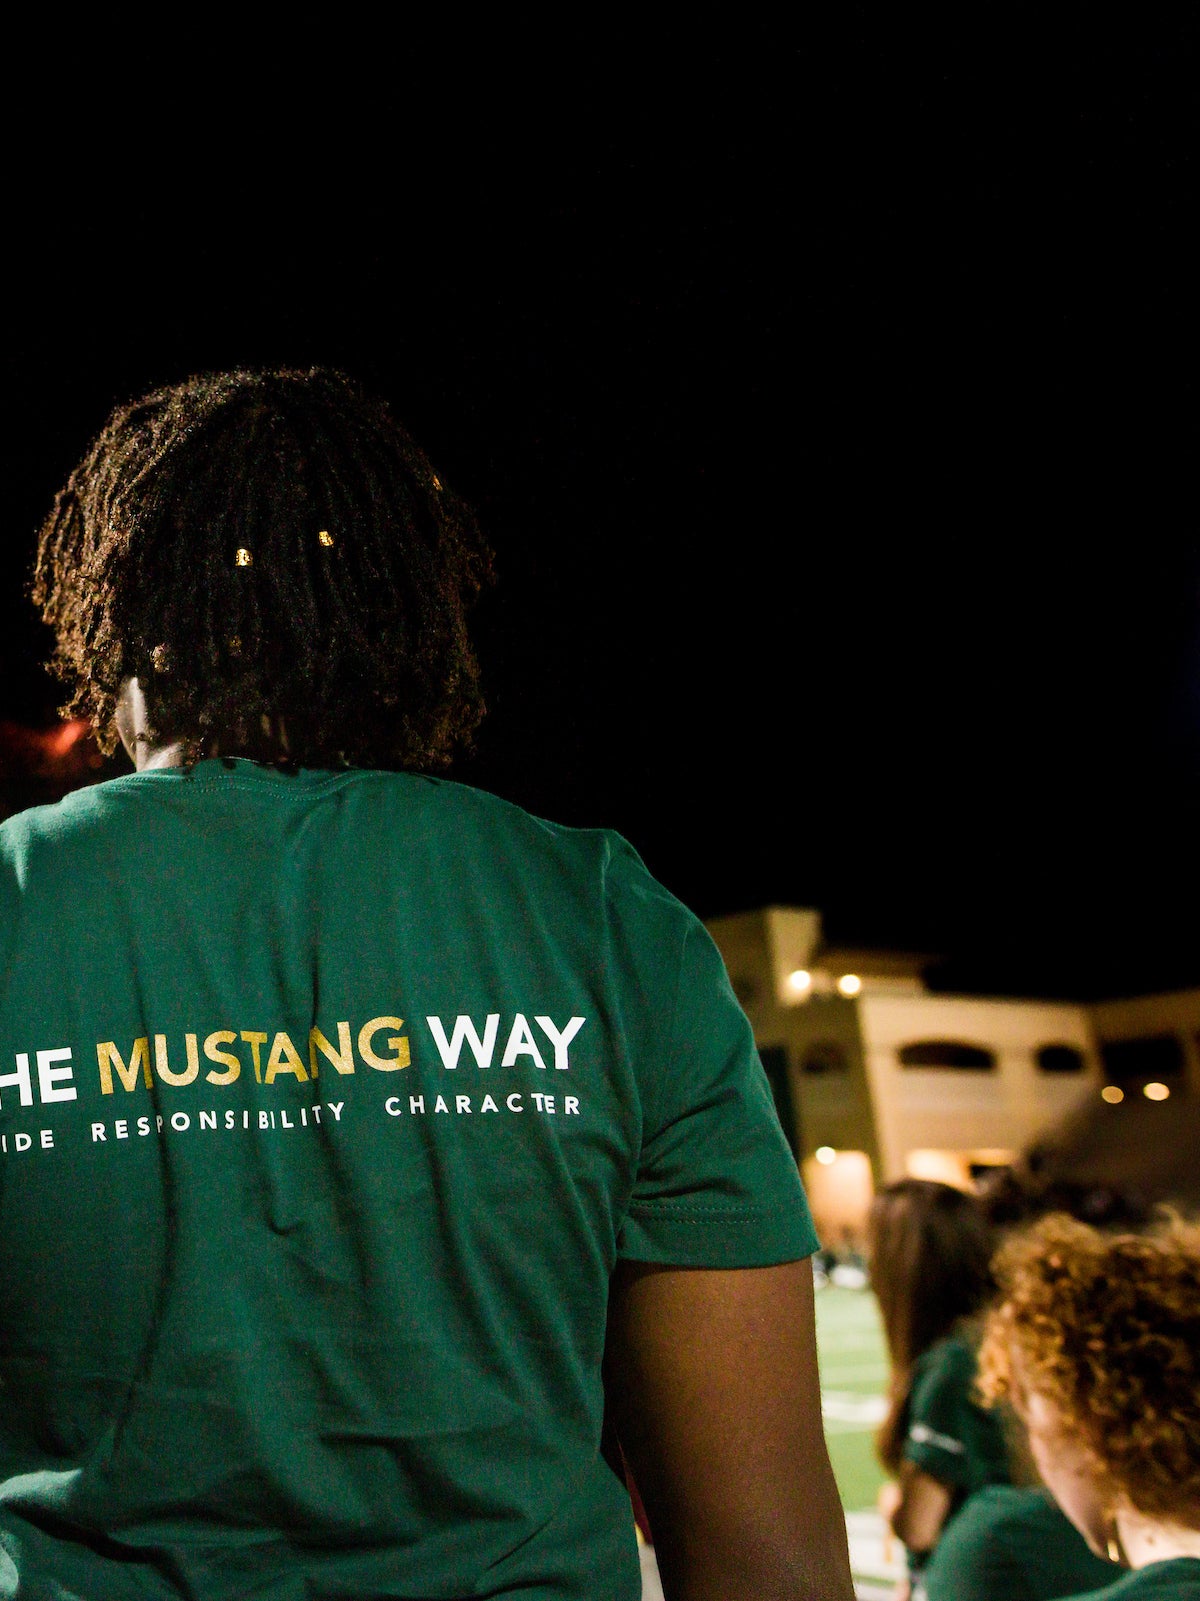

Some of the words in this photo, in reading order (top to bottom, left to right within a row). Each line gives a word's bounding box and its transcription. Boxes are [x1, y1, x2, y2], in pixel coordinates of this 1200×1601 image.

[97, 1016, 411, 1094] MUSTANG
[426, 1013, 587, 1070] WAY
[92, 1102, 344, 1142] RESPONSIBILITY
[384, 1093, 580, 1116] CHARACTER
